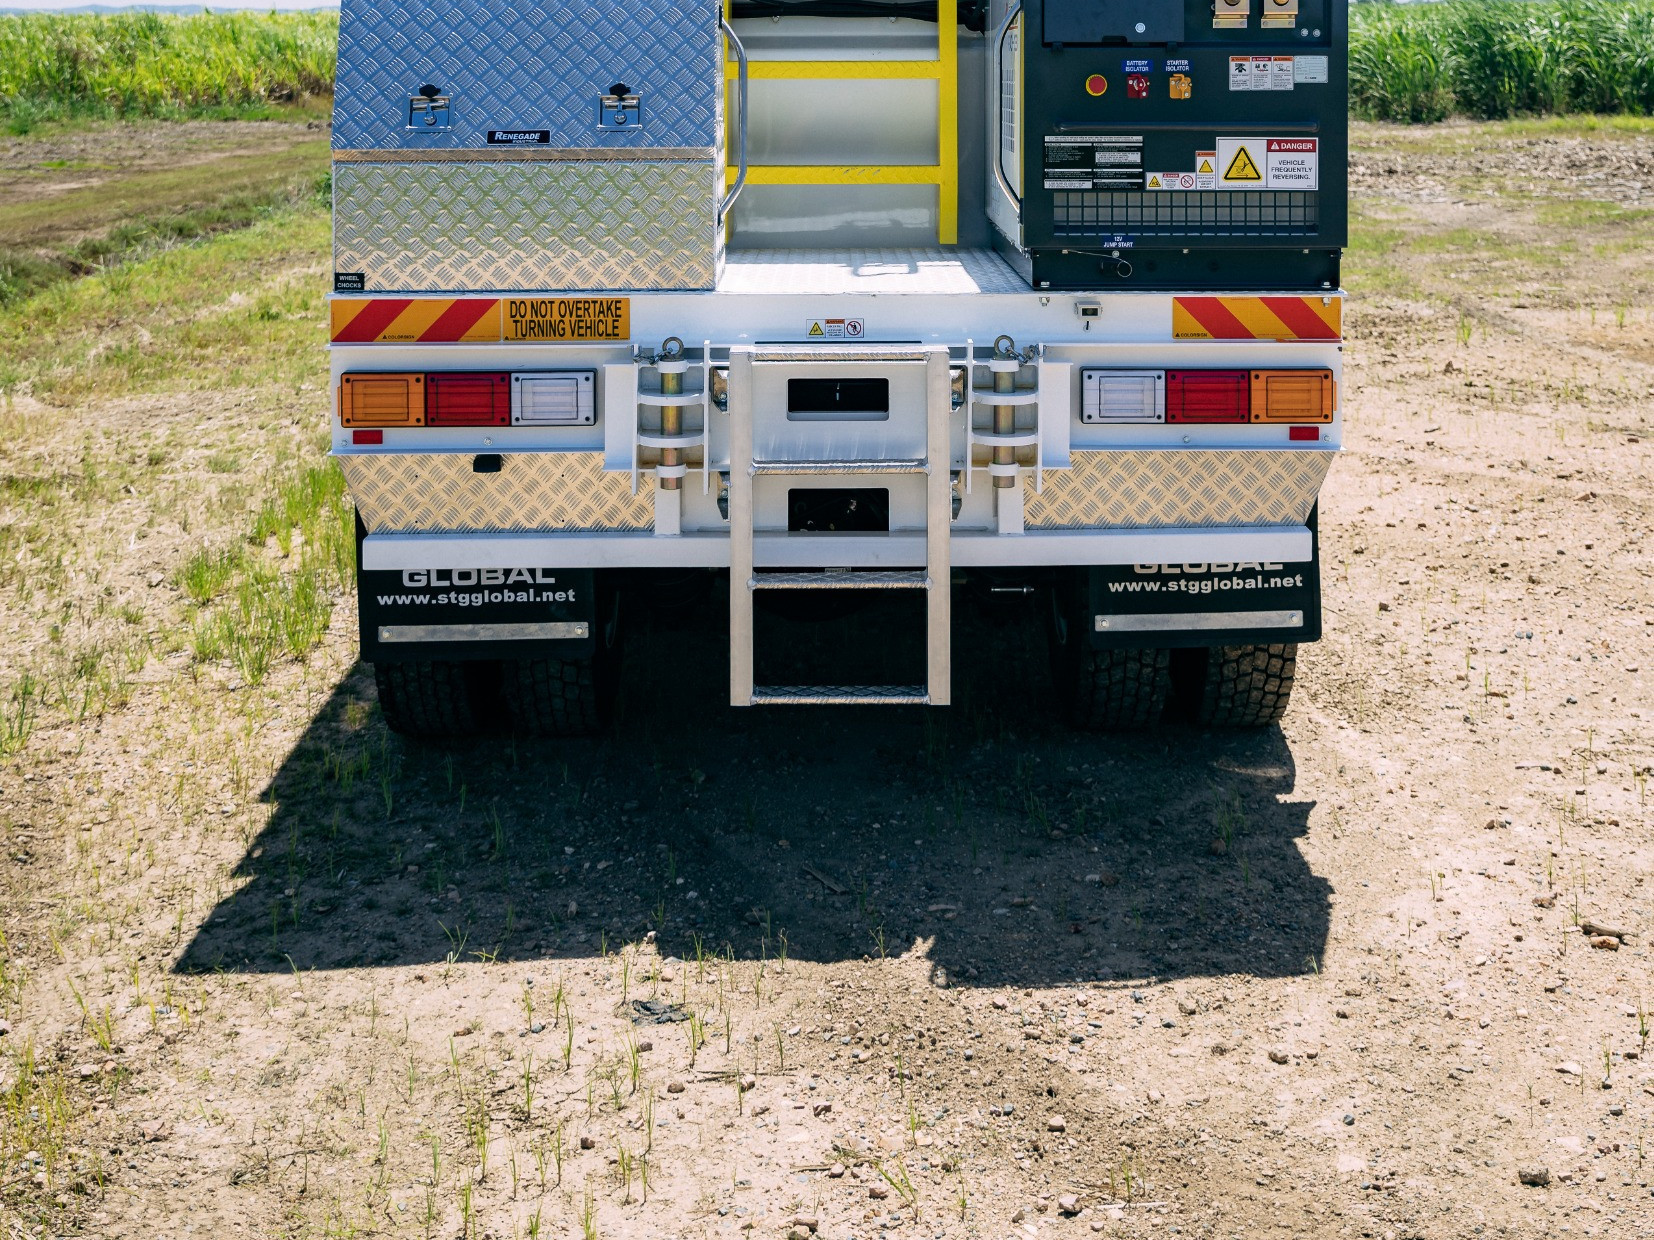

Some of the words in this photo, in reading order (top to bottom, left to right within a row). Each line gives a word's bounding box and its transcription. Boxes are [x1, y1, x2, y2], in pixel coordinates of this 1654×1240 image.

[494, 132, 540, 140] RENEGADE
[510, 300, 528, 318] DO
[530, 300, 555, 318] NOT
[558, 300, 622, 318] OVERTAKE
[513, 320, 566, 338] TURNING
[569, 319, 620, 337] VEHICLE
[402, 568, 556, 587] GLOBAL
[1108, 574, 1303, 594] www.stgglobal.net
[376, 589, 576, 606] www.stgglobal.net
